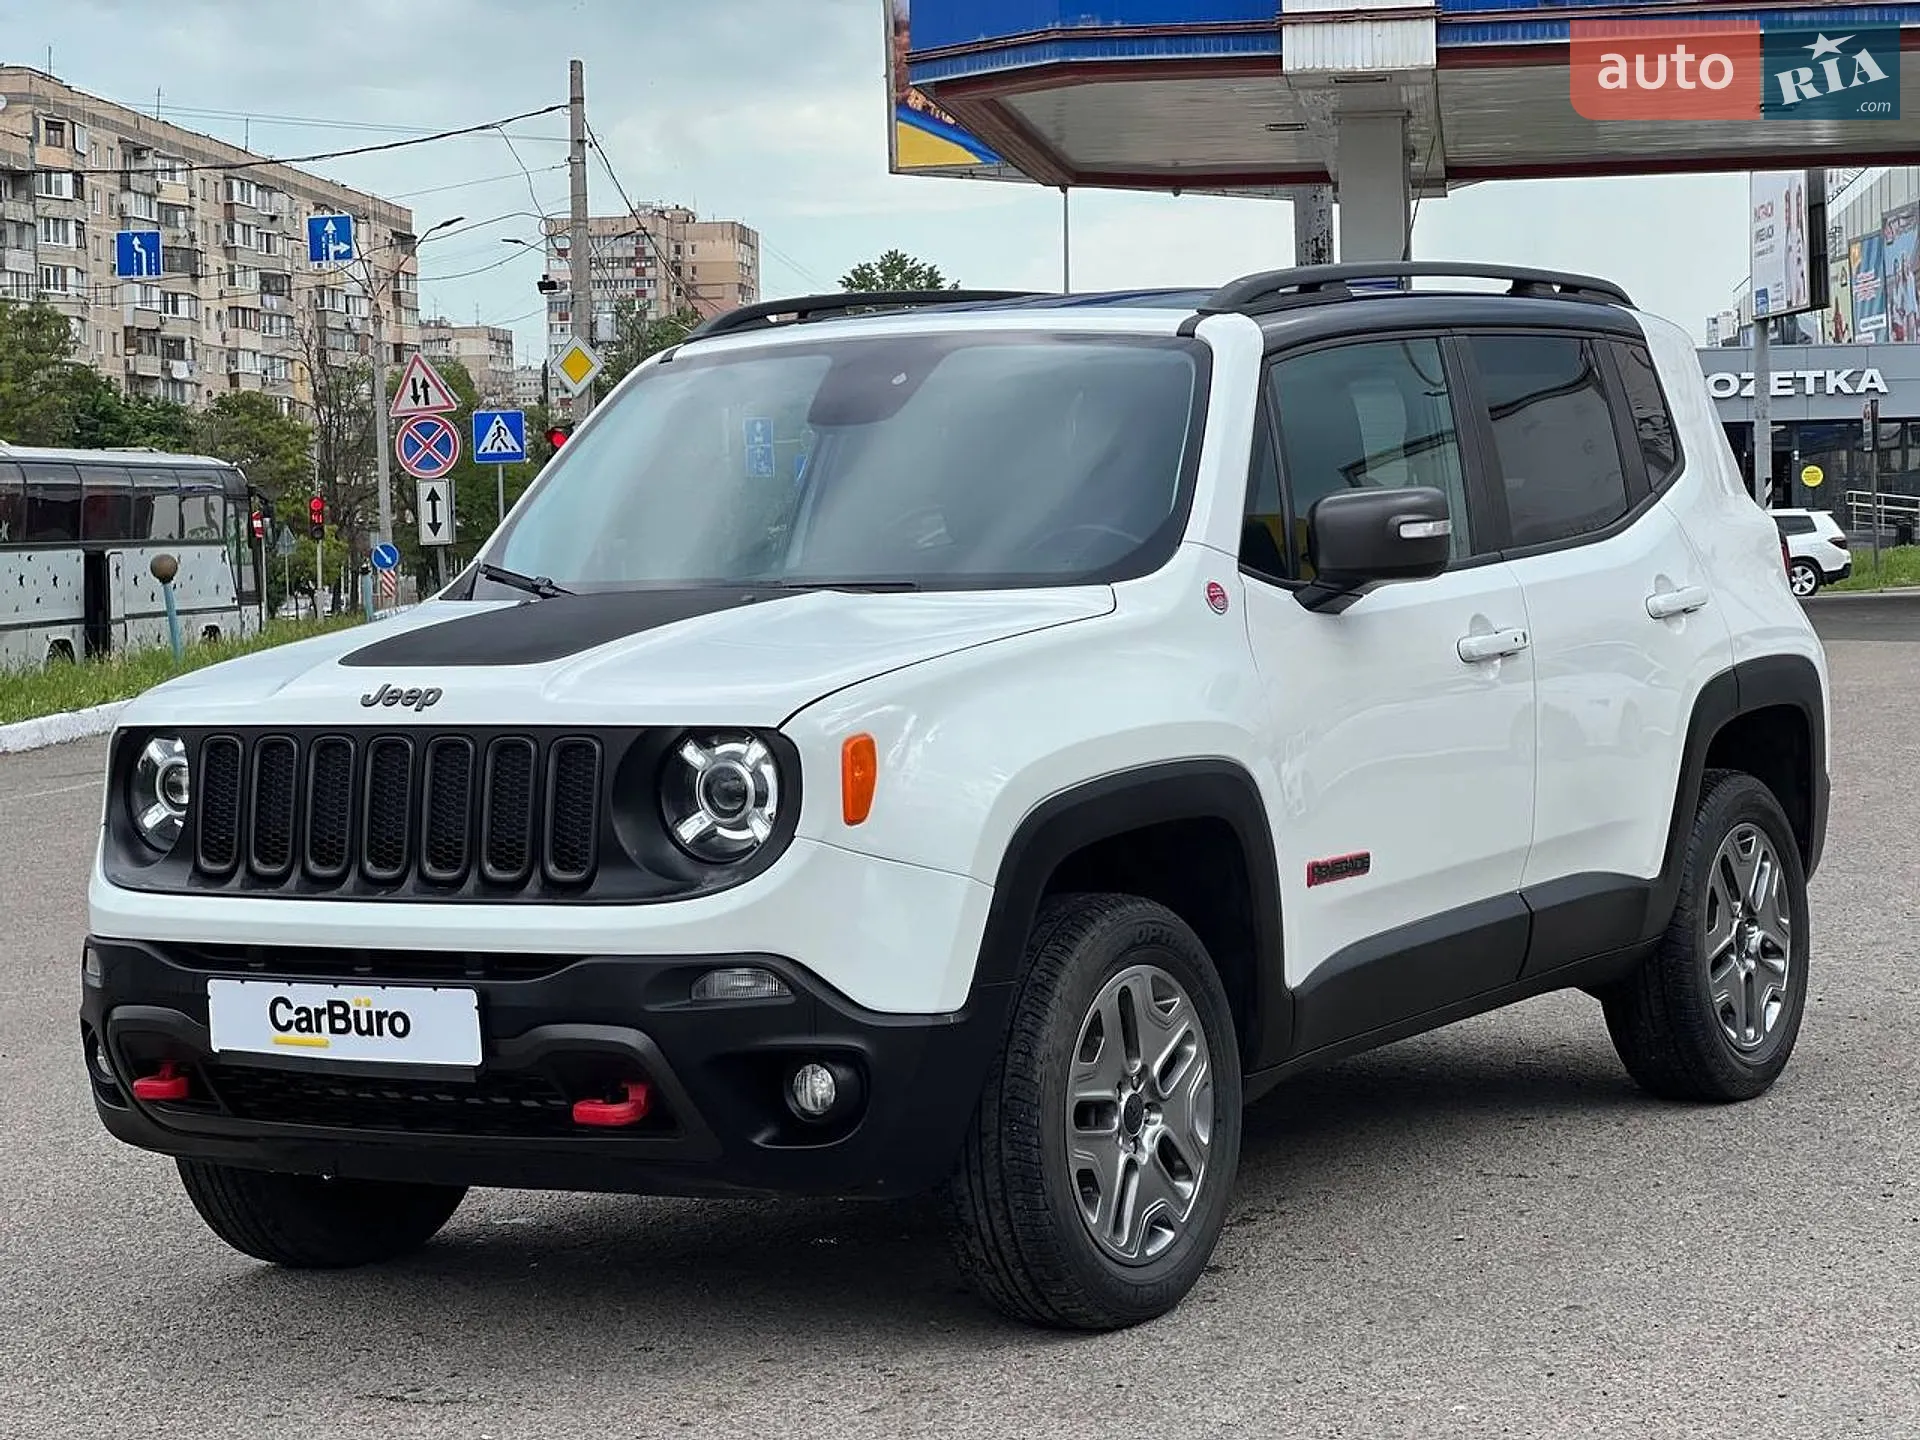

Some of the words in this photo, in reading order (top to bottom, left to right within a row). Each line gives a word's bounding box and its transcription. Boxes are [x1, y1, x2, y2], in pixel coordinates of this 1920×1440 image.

[1704, 368, 1889, 398] OZETKA
[360, 683, 443, 712] Jeep
[269, 995, 411, 1038] CarBüro
